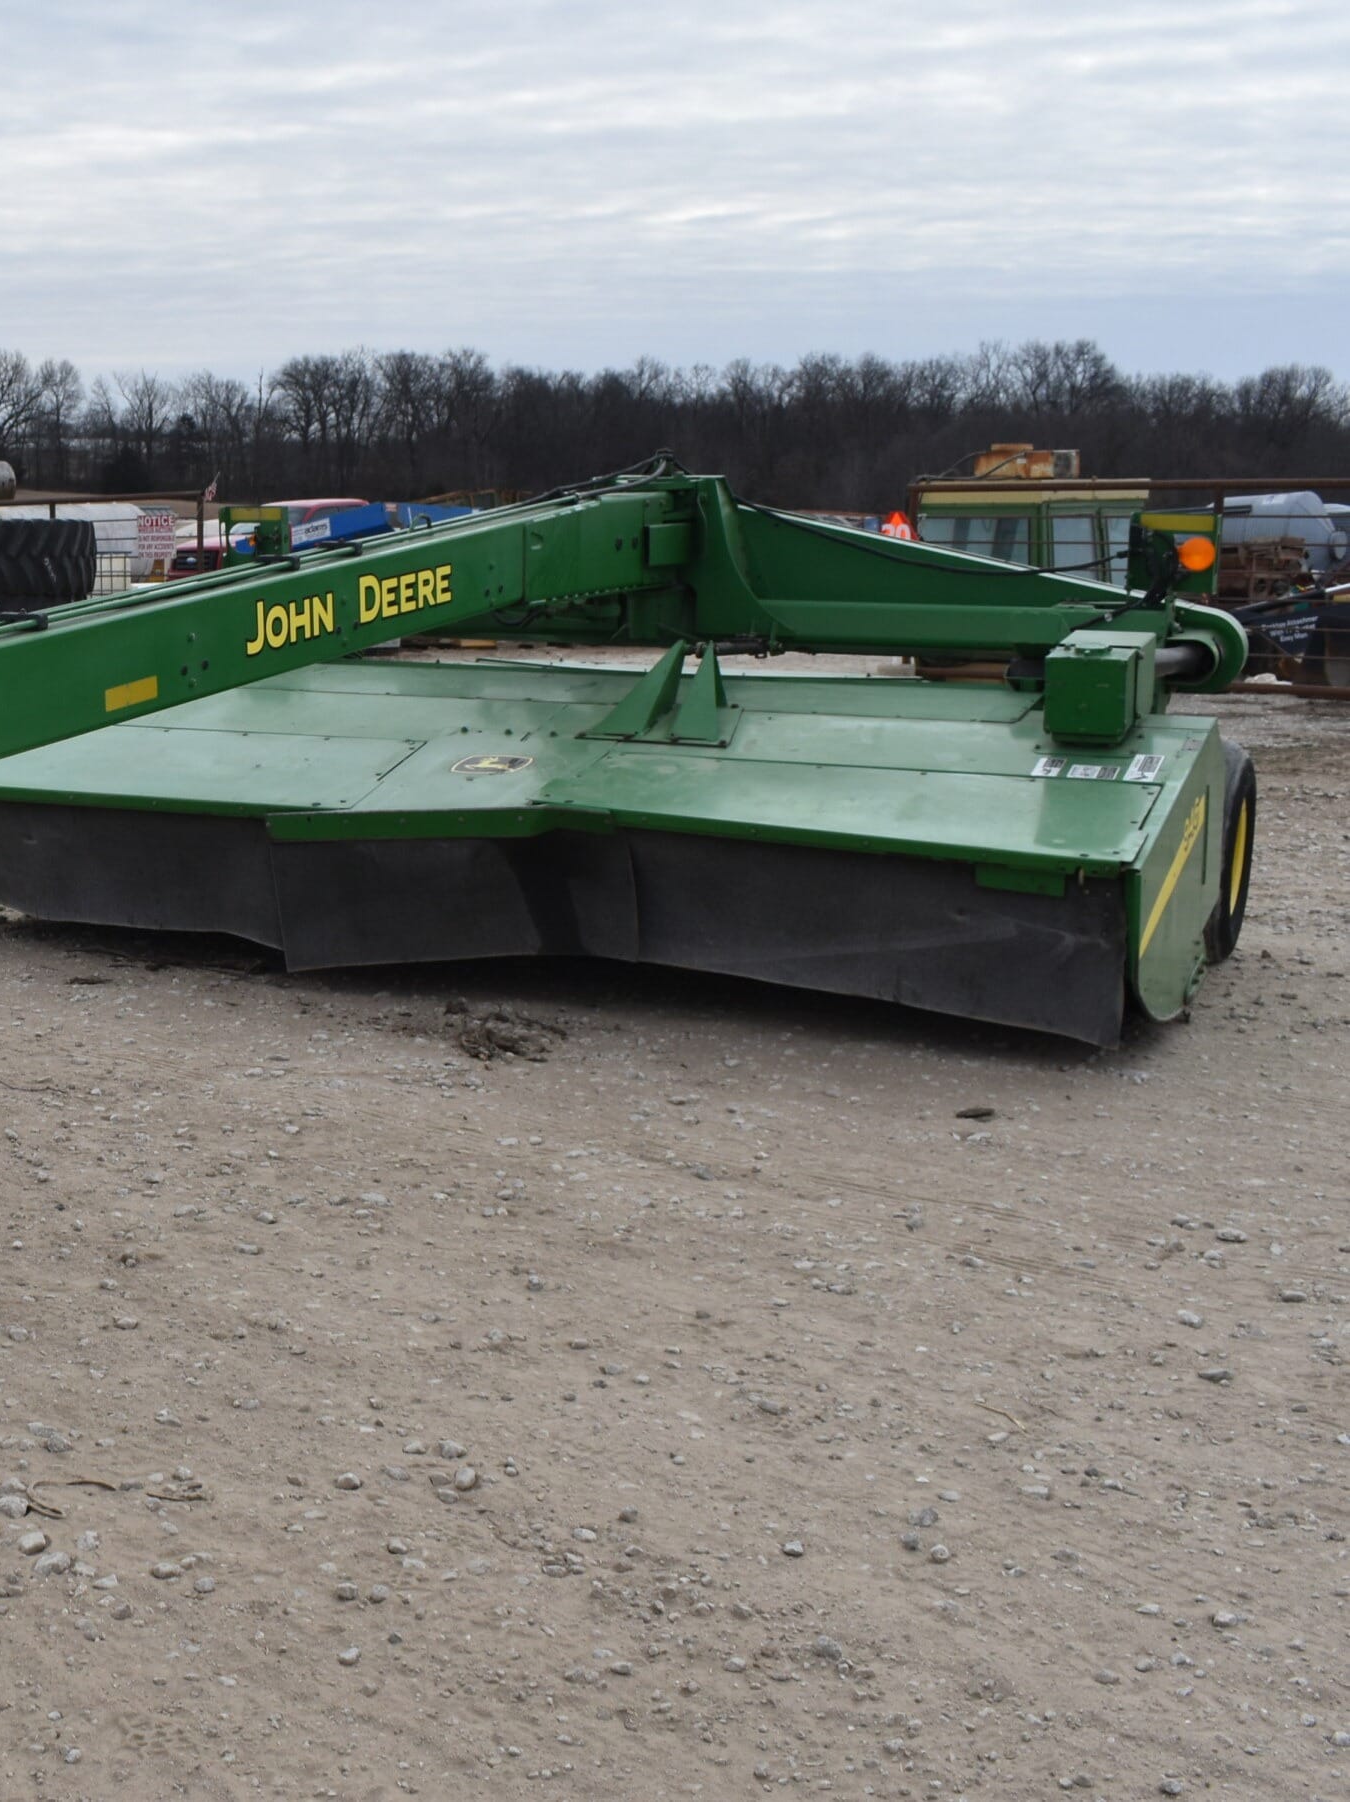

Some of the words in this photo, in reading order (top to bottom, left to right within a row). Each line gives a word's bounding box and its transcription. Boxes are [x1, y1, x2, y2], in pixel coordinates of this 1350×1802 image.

[138, 515, 175, 527] NOTICE
[246, 592, 334, 656] JOHN
[358, 564, 452, 624] DEERE
